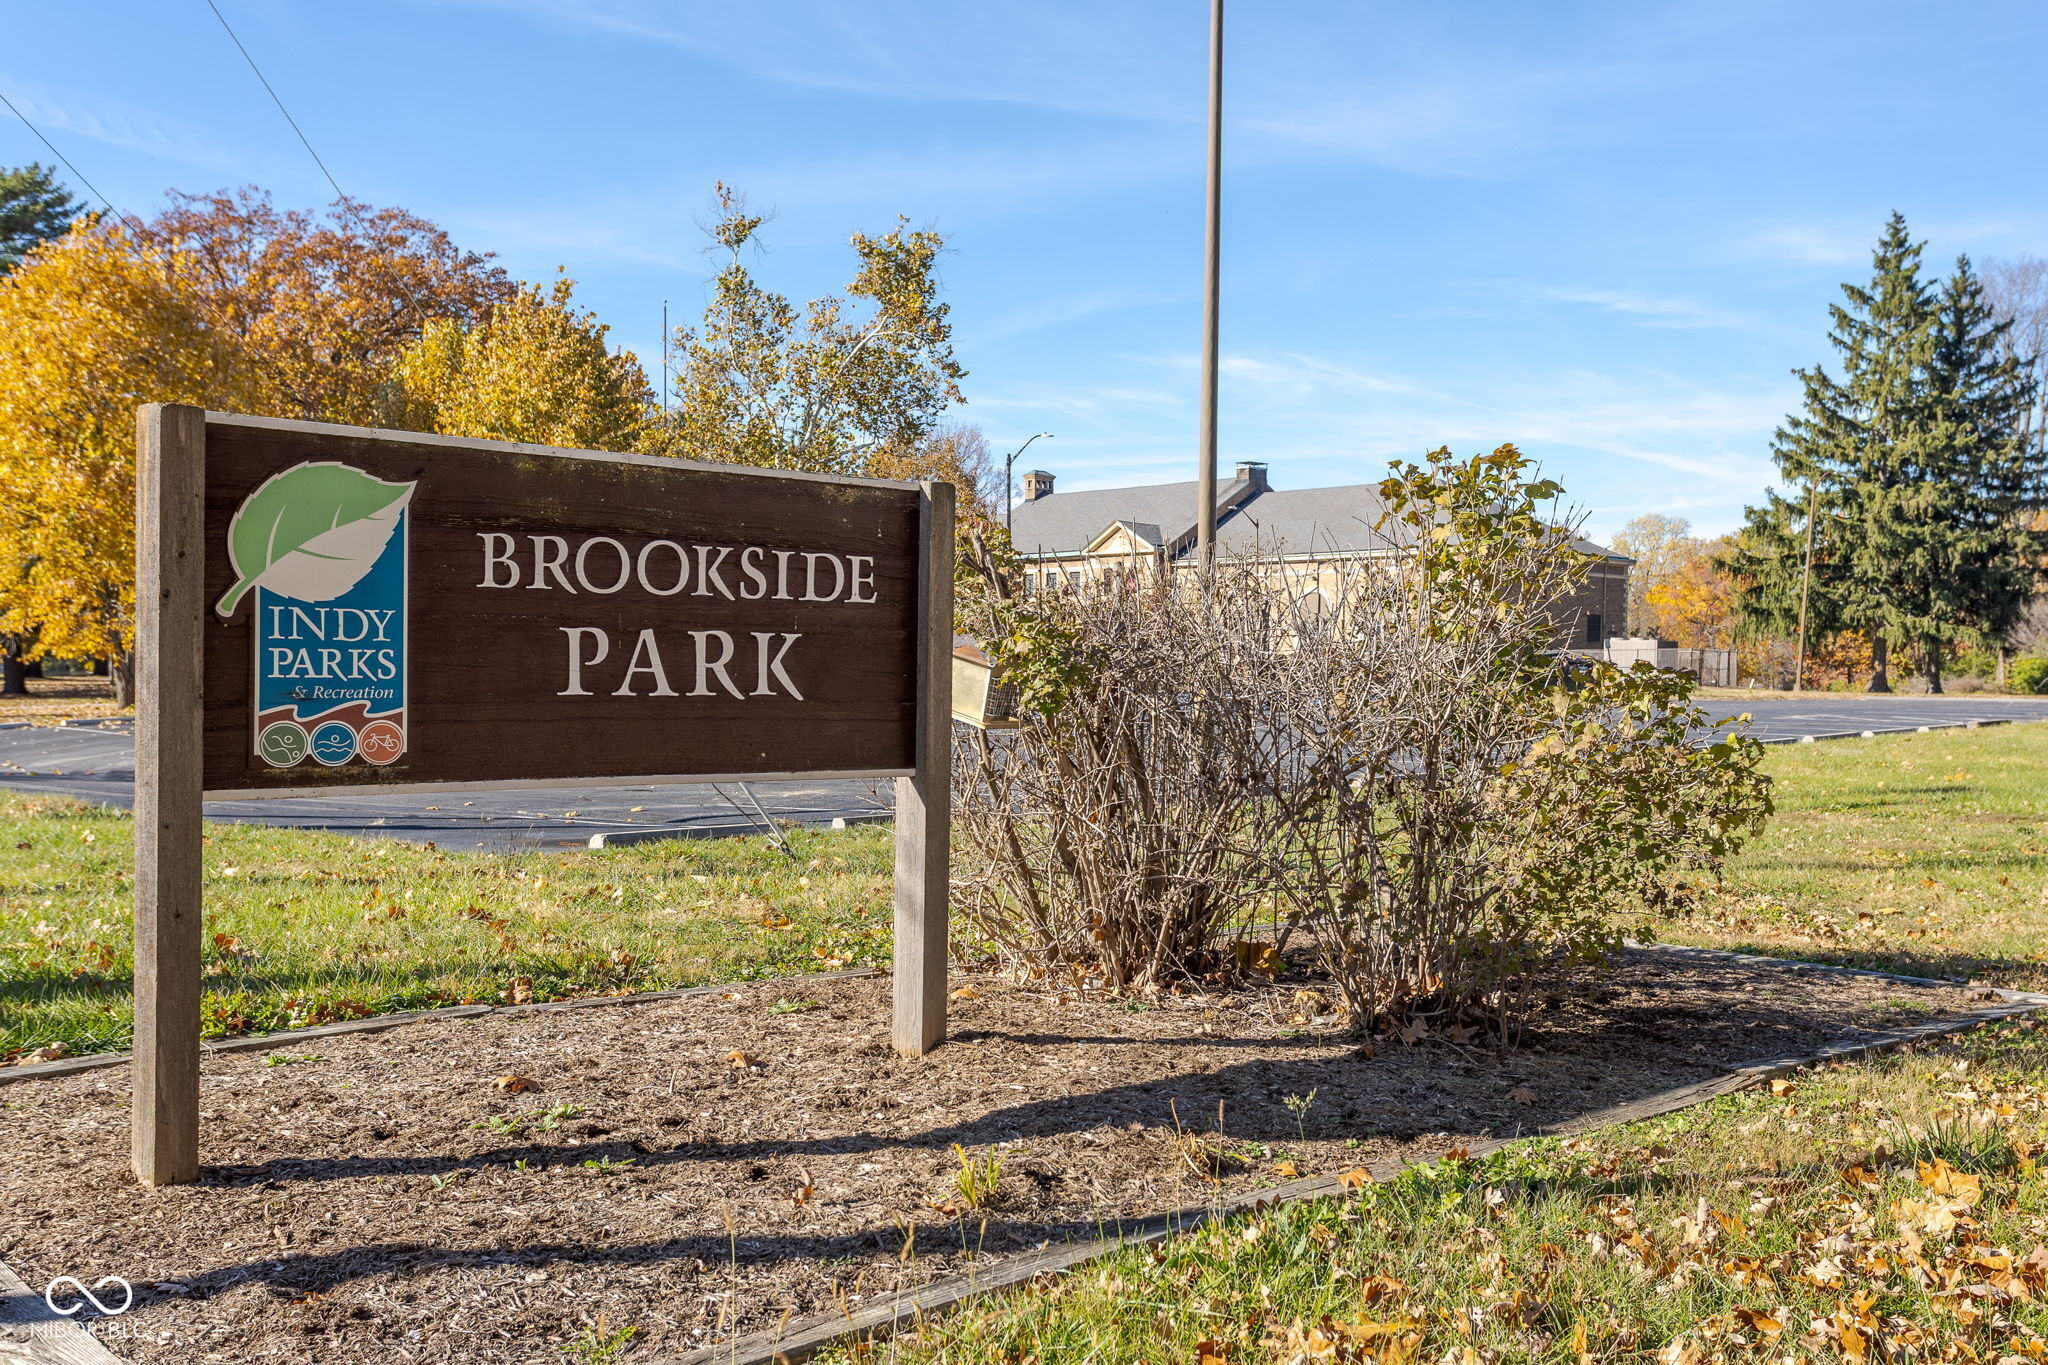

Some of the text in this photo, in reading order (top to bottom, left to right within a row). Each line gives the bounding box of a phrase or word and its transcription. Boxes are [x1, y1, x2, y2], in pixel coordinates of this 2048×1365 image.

[476, 532, 878, 604] BROOKSIDE
[268, 606, 396, 642] INDY
[268, 647, 396, 682] PARKS
[557, 627, 804, 701] PARK
[293, 685, 394, 699] & Recreation
